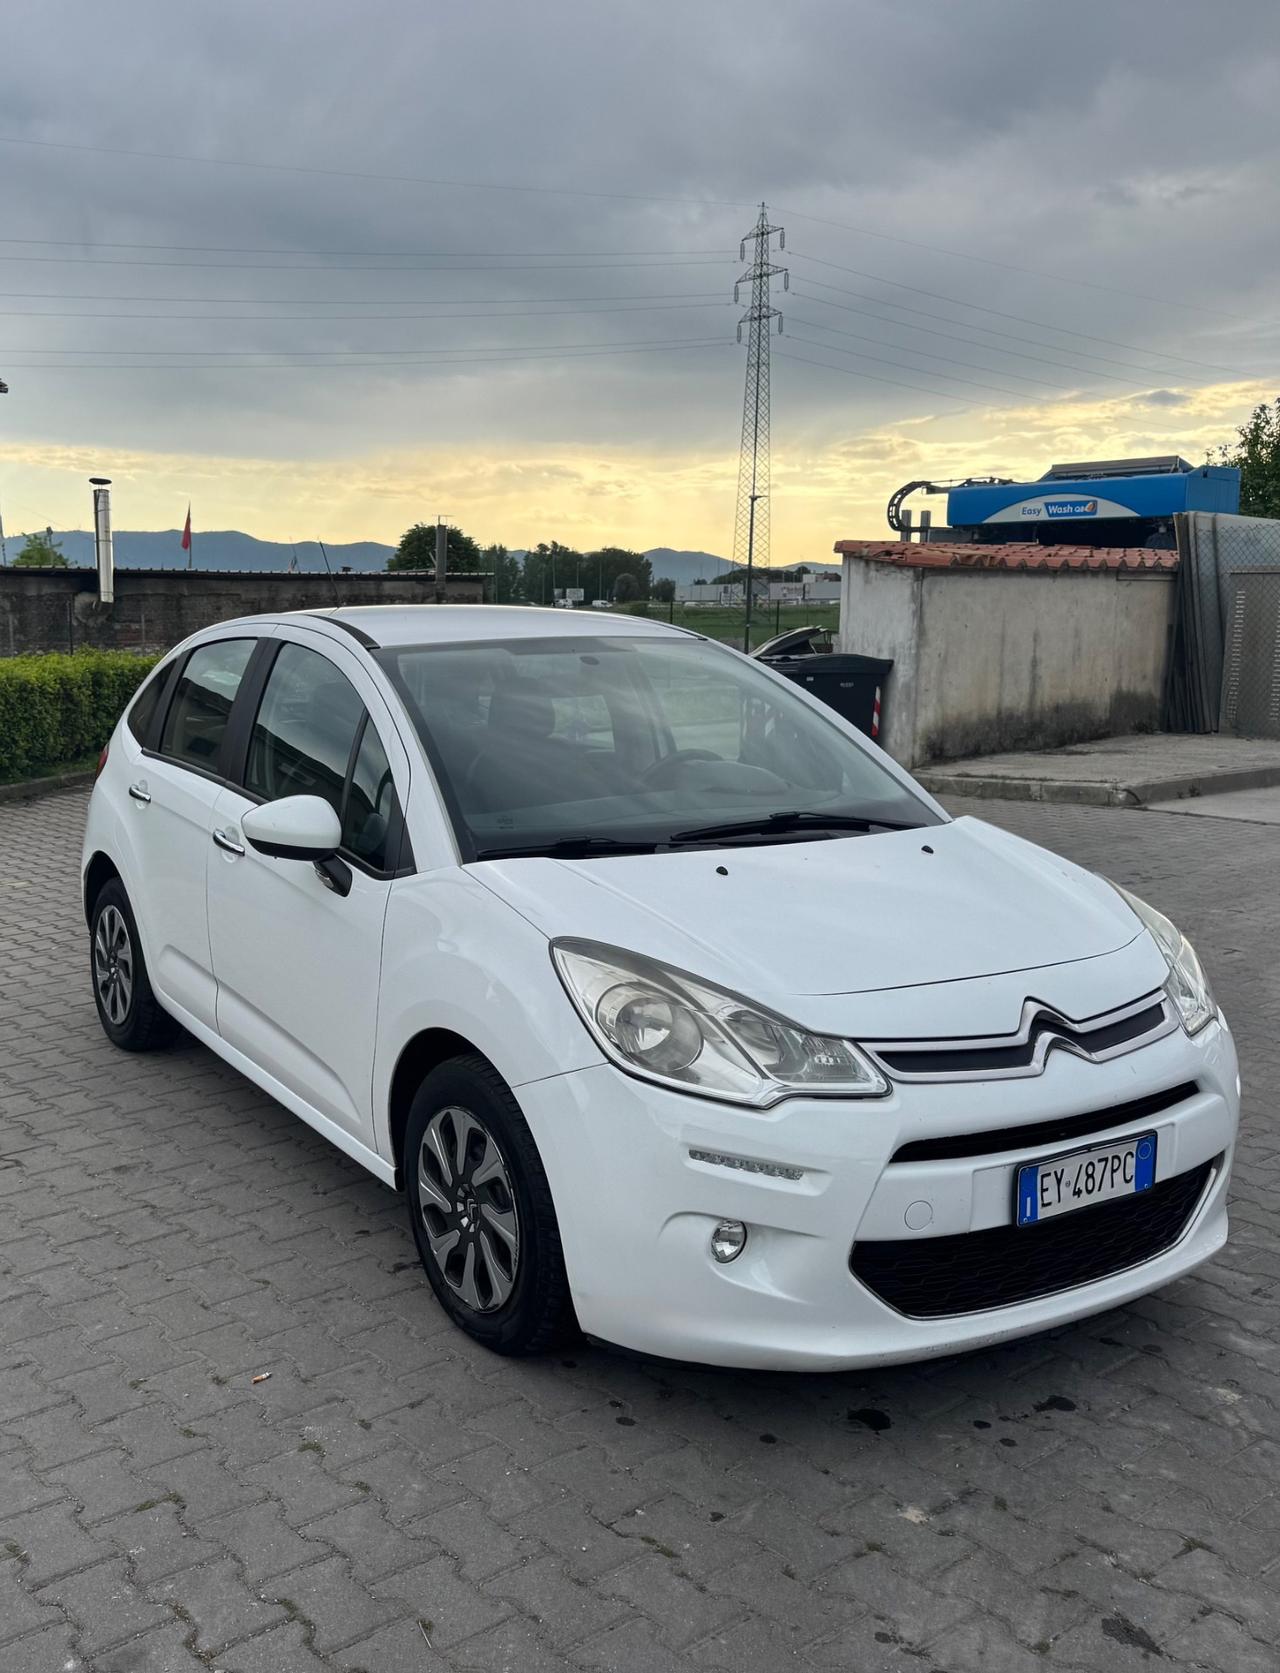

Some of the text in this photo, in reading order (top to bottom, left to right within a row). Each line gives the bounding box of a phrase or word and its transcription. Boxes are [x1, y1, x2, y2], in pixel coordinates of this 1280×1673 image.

[1022, 507, 1042, 516] Easy
[1048, 505, 1073, 514] Wash
[1040, 1151, 1135, 1208] EY 487PC
[1026, 1197, 1031, 1217] I
